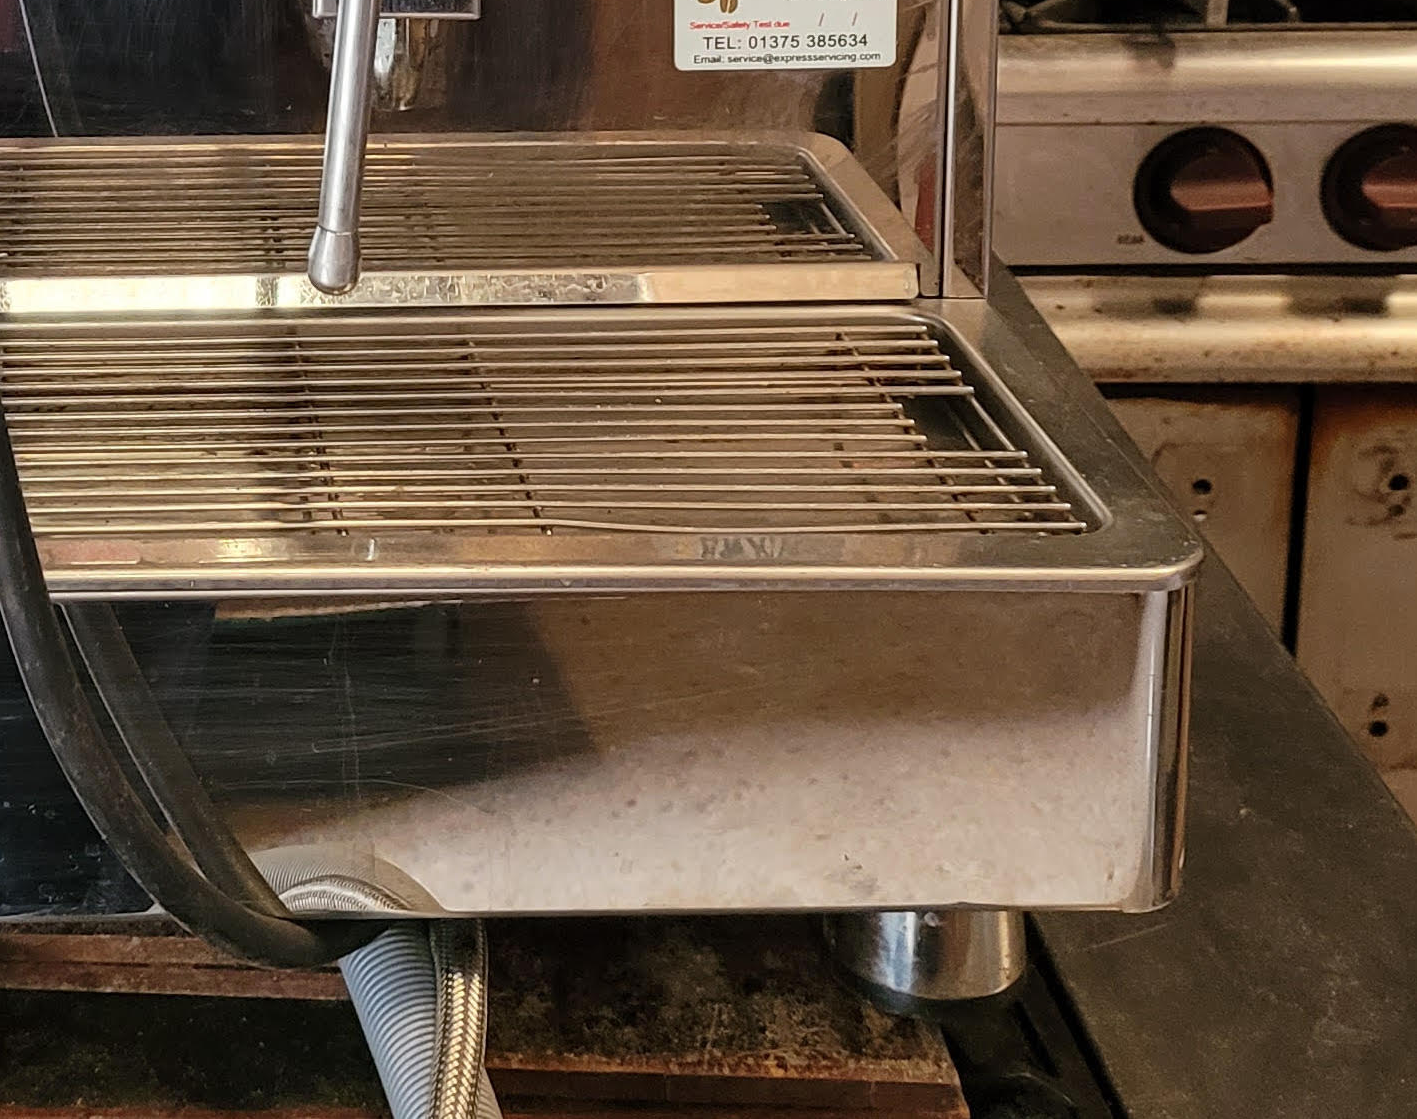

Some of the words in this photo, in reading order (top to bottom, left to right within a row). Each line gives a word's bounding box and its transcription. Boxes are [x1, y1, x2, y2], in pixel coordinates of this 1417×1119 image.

[753, 20, 771, 29] Test
[774, 20, 790, 28] due
[703, 37, 741, 50] TEL:
[748, 35, 800, 49] 01375
[806, 34, 868, 48] 385634
[693, 55, 725, 65] Email:
